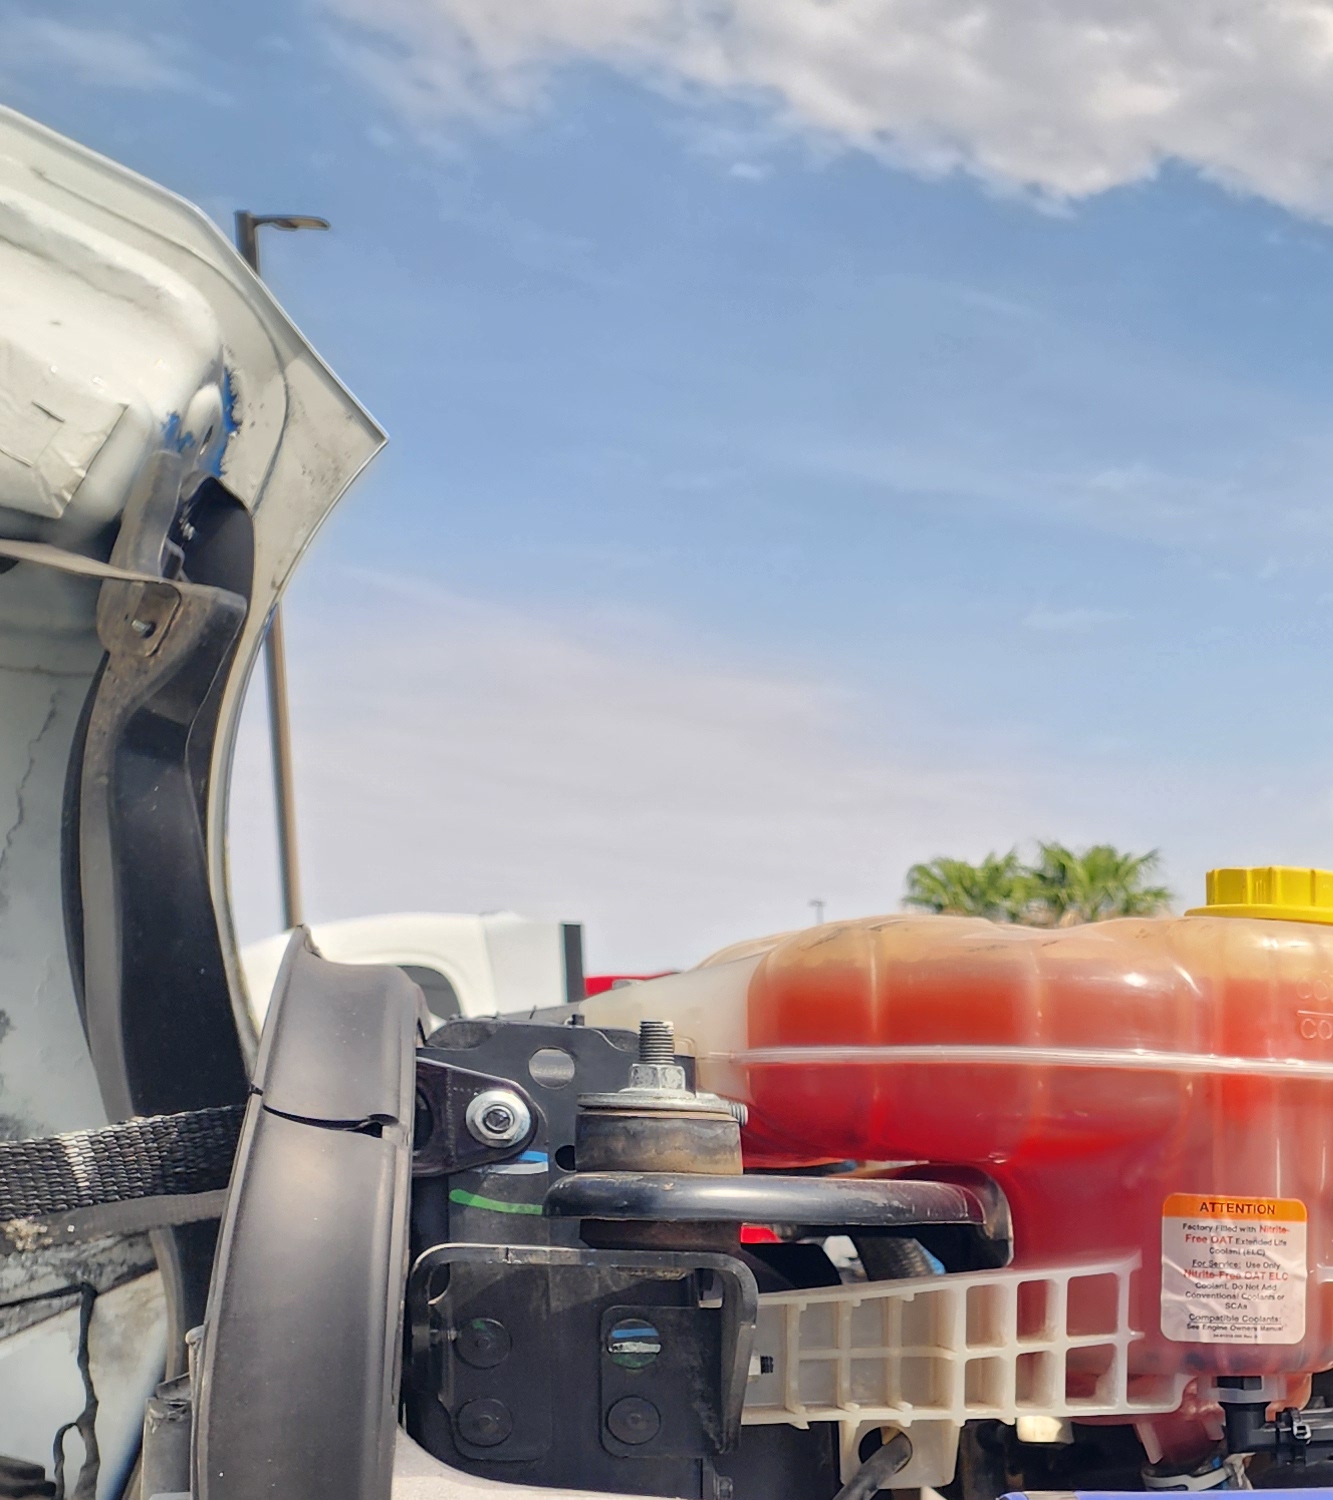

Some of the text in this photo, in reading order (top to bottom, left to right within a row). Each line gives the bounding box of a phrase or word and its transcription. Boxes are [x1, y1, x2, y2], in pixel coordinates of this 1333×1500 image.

[1200, 1201, 1276, 1215] ATTENTION
[1182, 1223, 1213, 1233] Factory
[1239, 1224, 1256, 1233] with
[1185, 1234, 1287, 1247] Free OAT Extended Life
[1192, 1259, 1207, 1268] For
[1245, 1261, 1261, 1269] Use
[1263, 1262, 1281, 1271] Only
[1244, 1272, 1267, 1281] OAT
[1269, 1272, 1289, 1281] ELC
[1232, 1283, 1243, 1291] Do
[1185, 1291, 1239, 1300] Conventional
[1225, 1302, 1248, 1310] SCAs
[1189, 1313, 1240, 1325] Compatible
